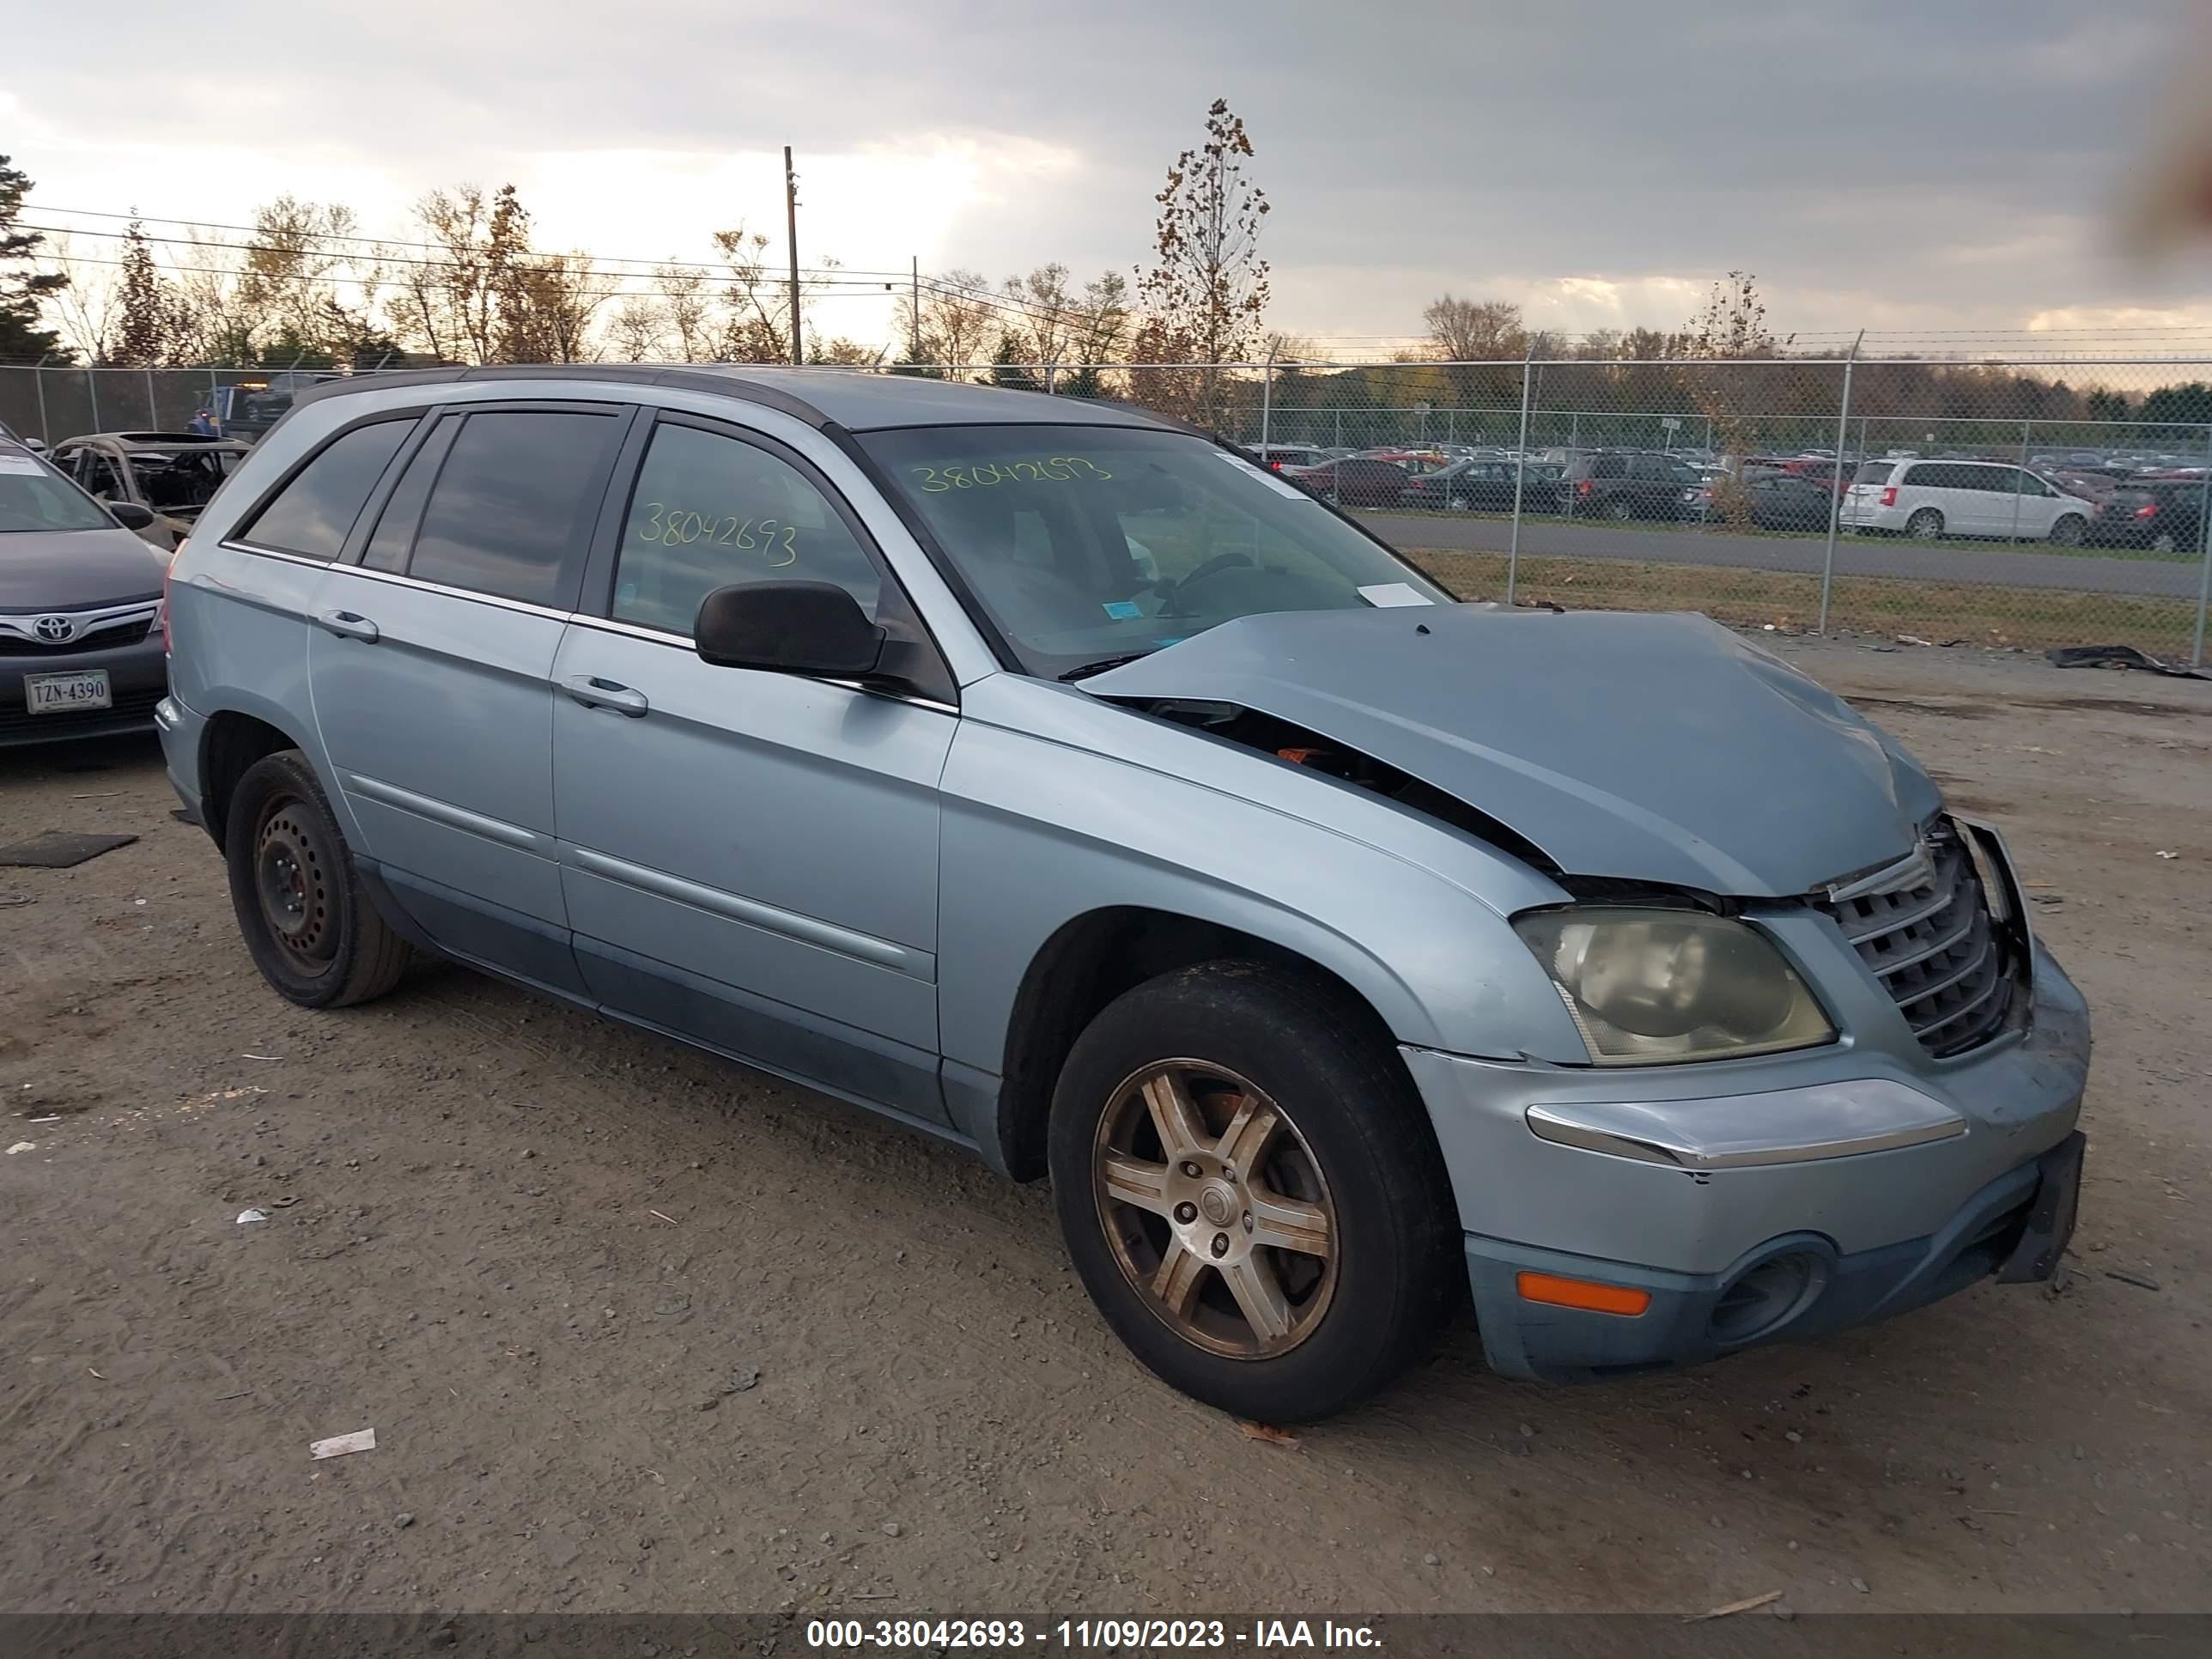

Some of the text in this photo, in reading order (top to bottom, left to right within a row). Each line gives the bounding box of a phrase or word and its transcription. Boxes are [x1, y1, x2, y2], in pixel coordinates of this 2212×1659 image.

[912, 457, 1112, 492] 38042693
[640, 502, 797, 568] 38042693
[34, 681, 104, 703] TZN-4390
